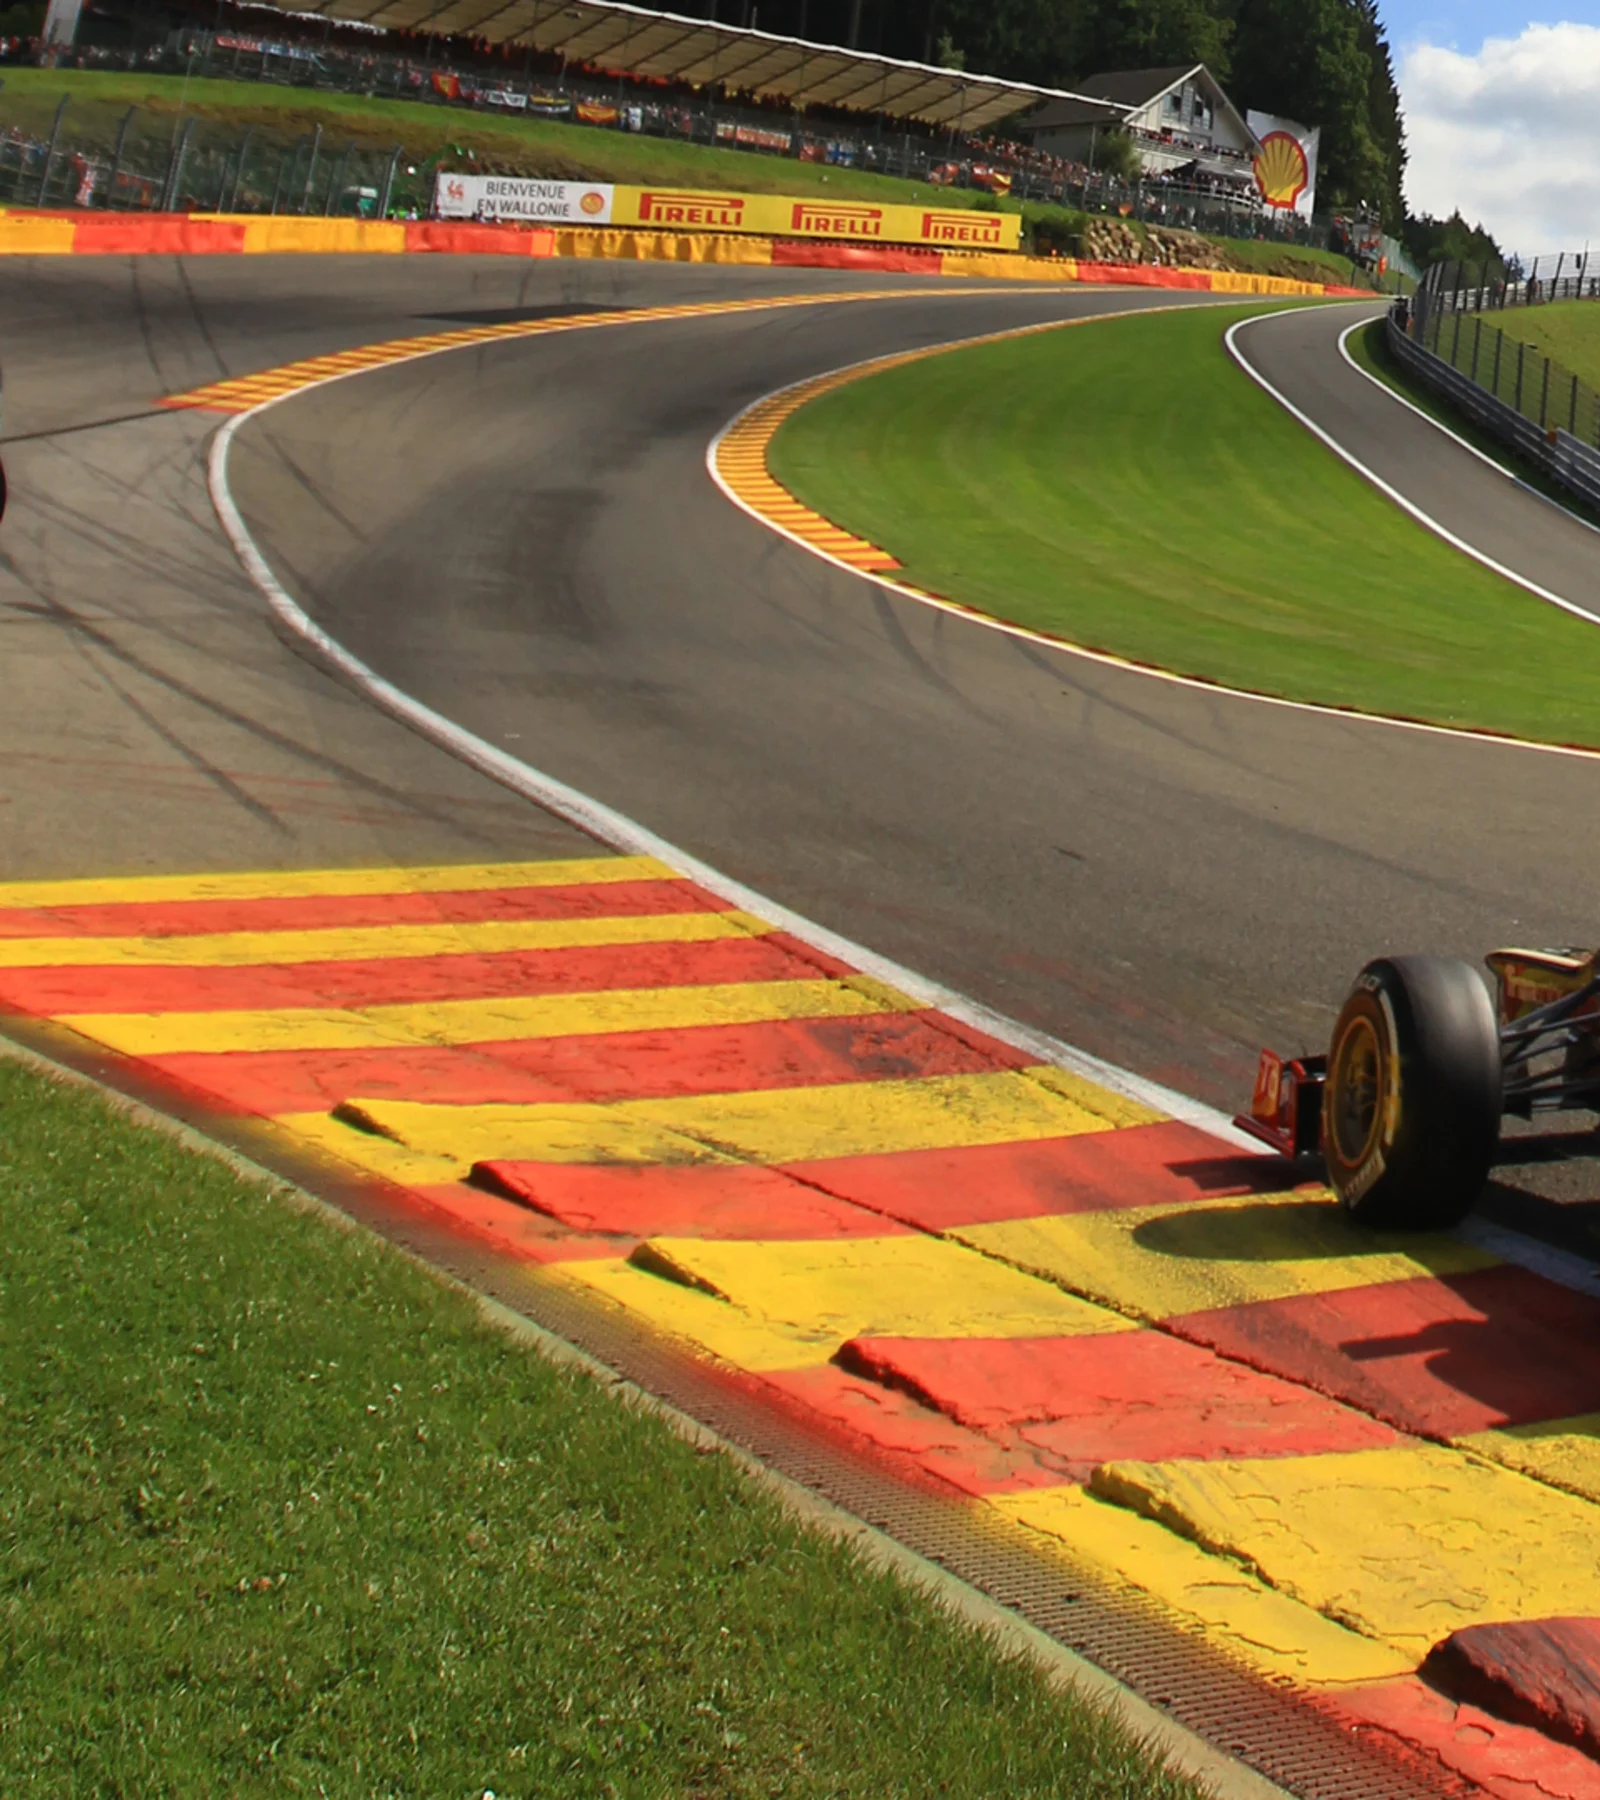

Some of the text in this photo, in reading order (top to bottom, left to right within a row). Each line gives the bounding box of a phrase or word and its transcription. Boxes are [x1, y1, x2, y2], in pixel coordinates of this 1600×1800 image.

[486, 180, 567, 199] BIENVENUE
[476, 199, 496, 213] EN
[500, 200, 570, 217] WALLONIE
[638, 192, 744, 226] PIRELLI
[791, 203, 882, 236] PIRELLI
[922, 213, 1002, 243] PIRELLI
